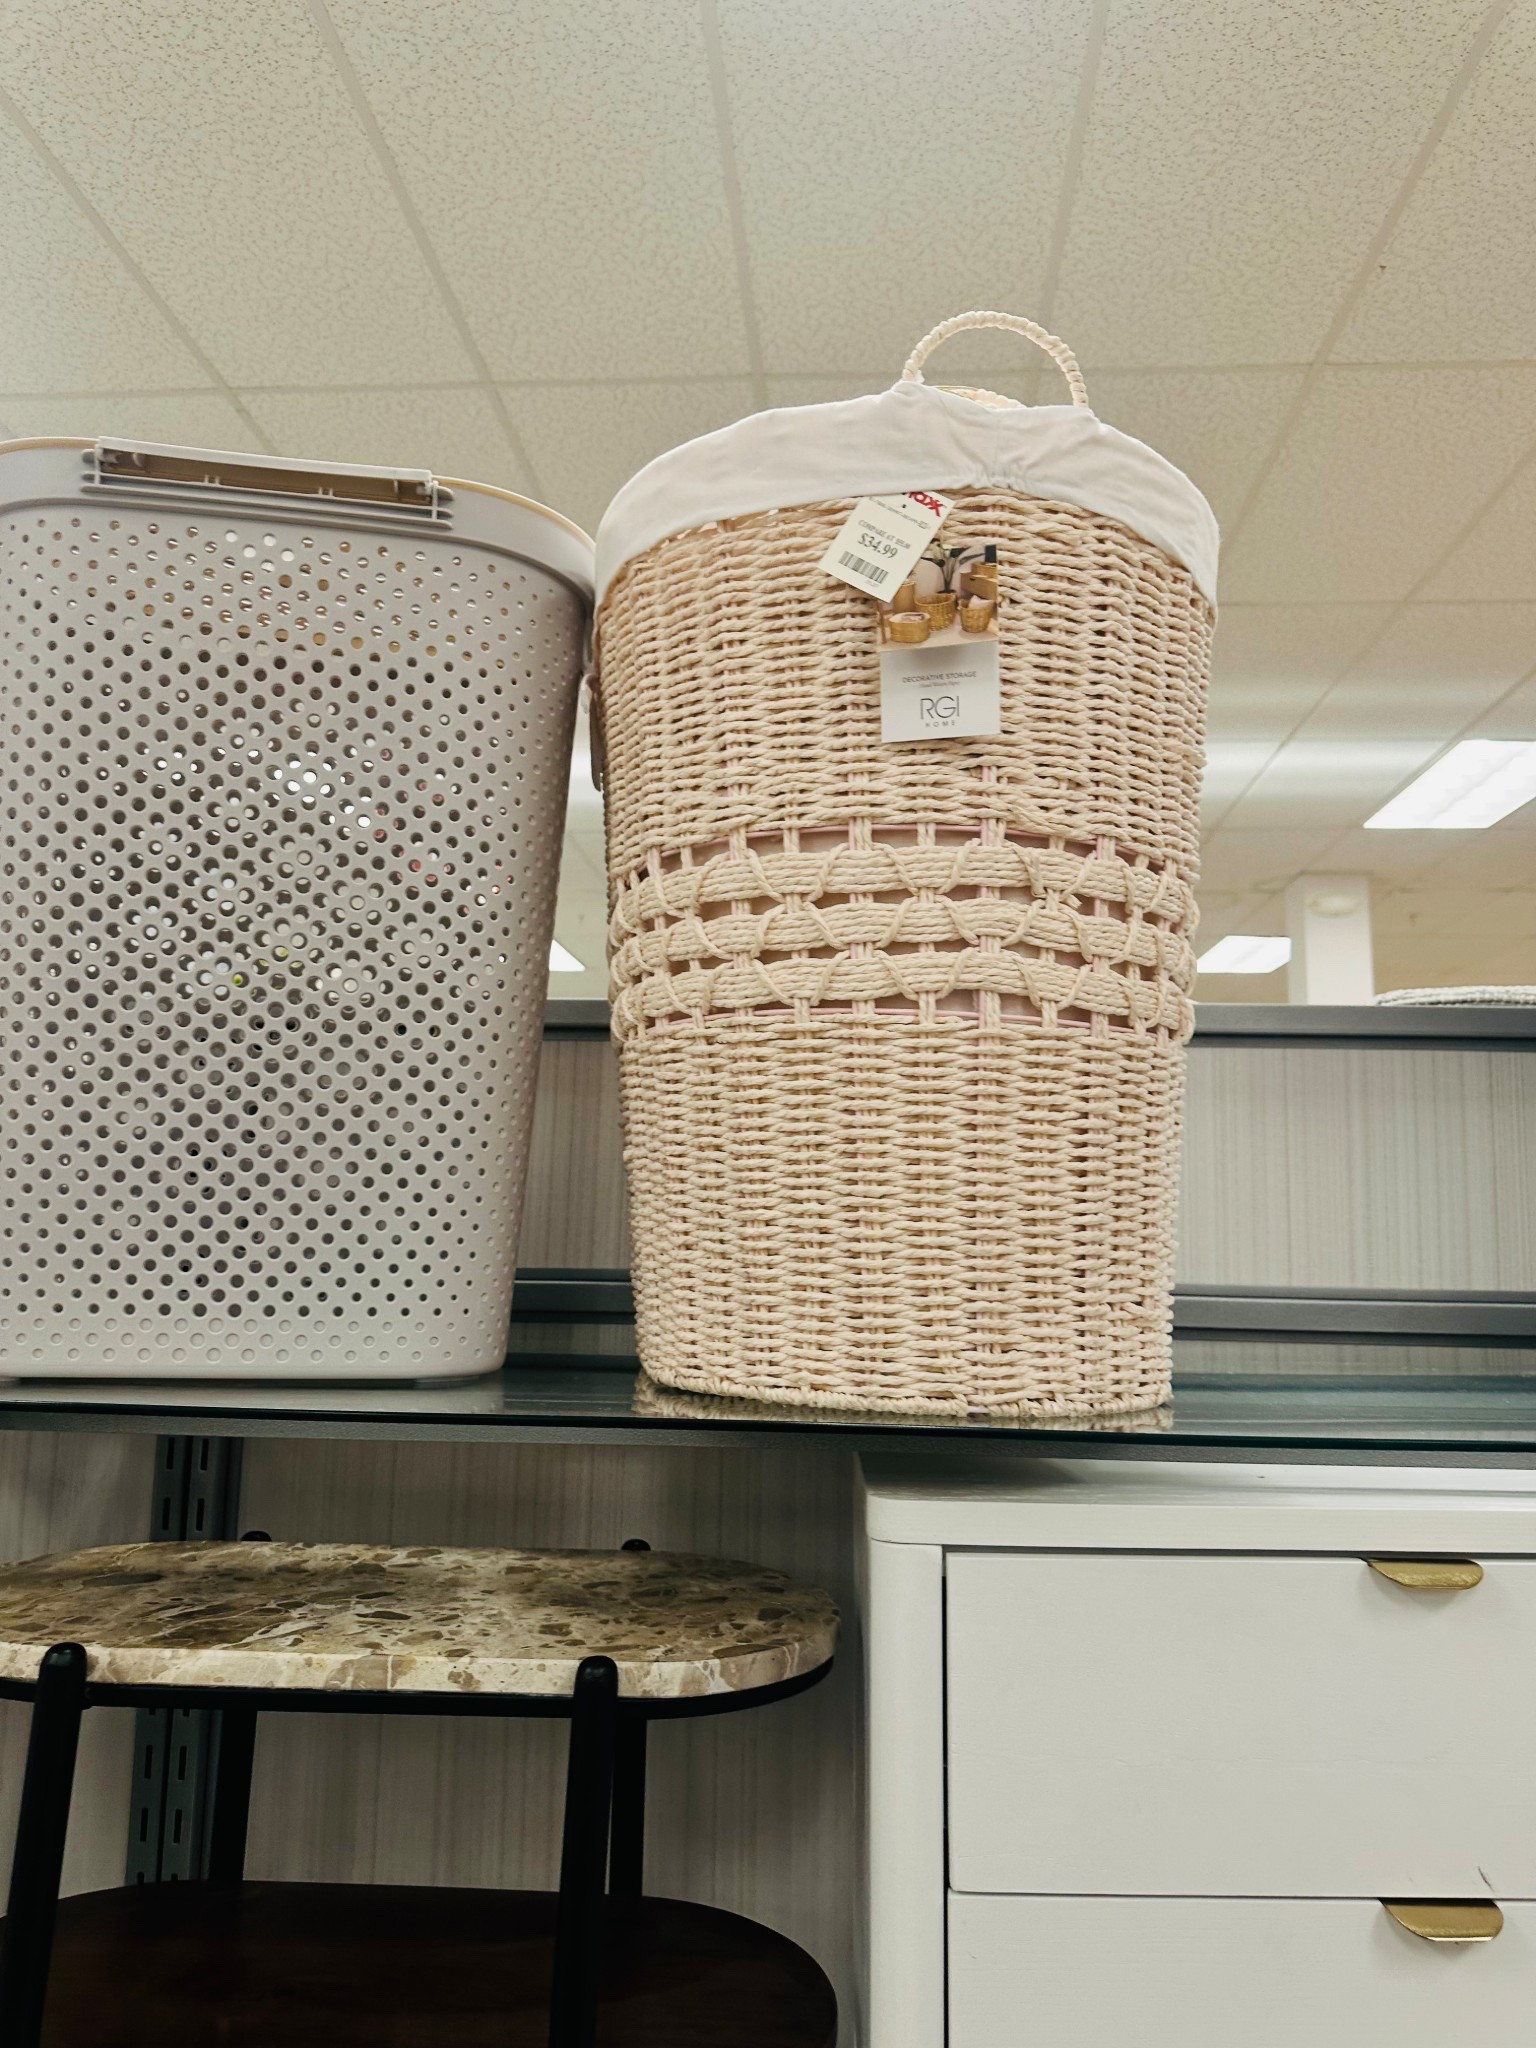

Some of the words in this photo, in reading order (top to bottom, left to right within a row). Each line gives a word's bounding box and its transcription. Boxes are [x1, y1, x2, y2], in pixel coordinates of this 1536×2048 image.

[857, 532, 898, 558] $34.99
[902, 673, 944, 683] DECORATIVE
[945, 670, 977, 680] STORAGE
[920, 696, 960, 720] RGI
[925, 719, 955, 728] HOME
